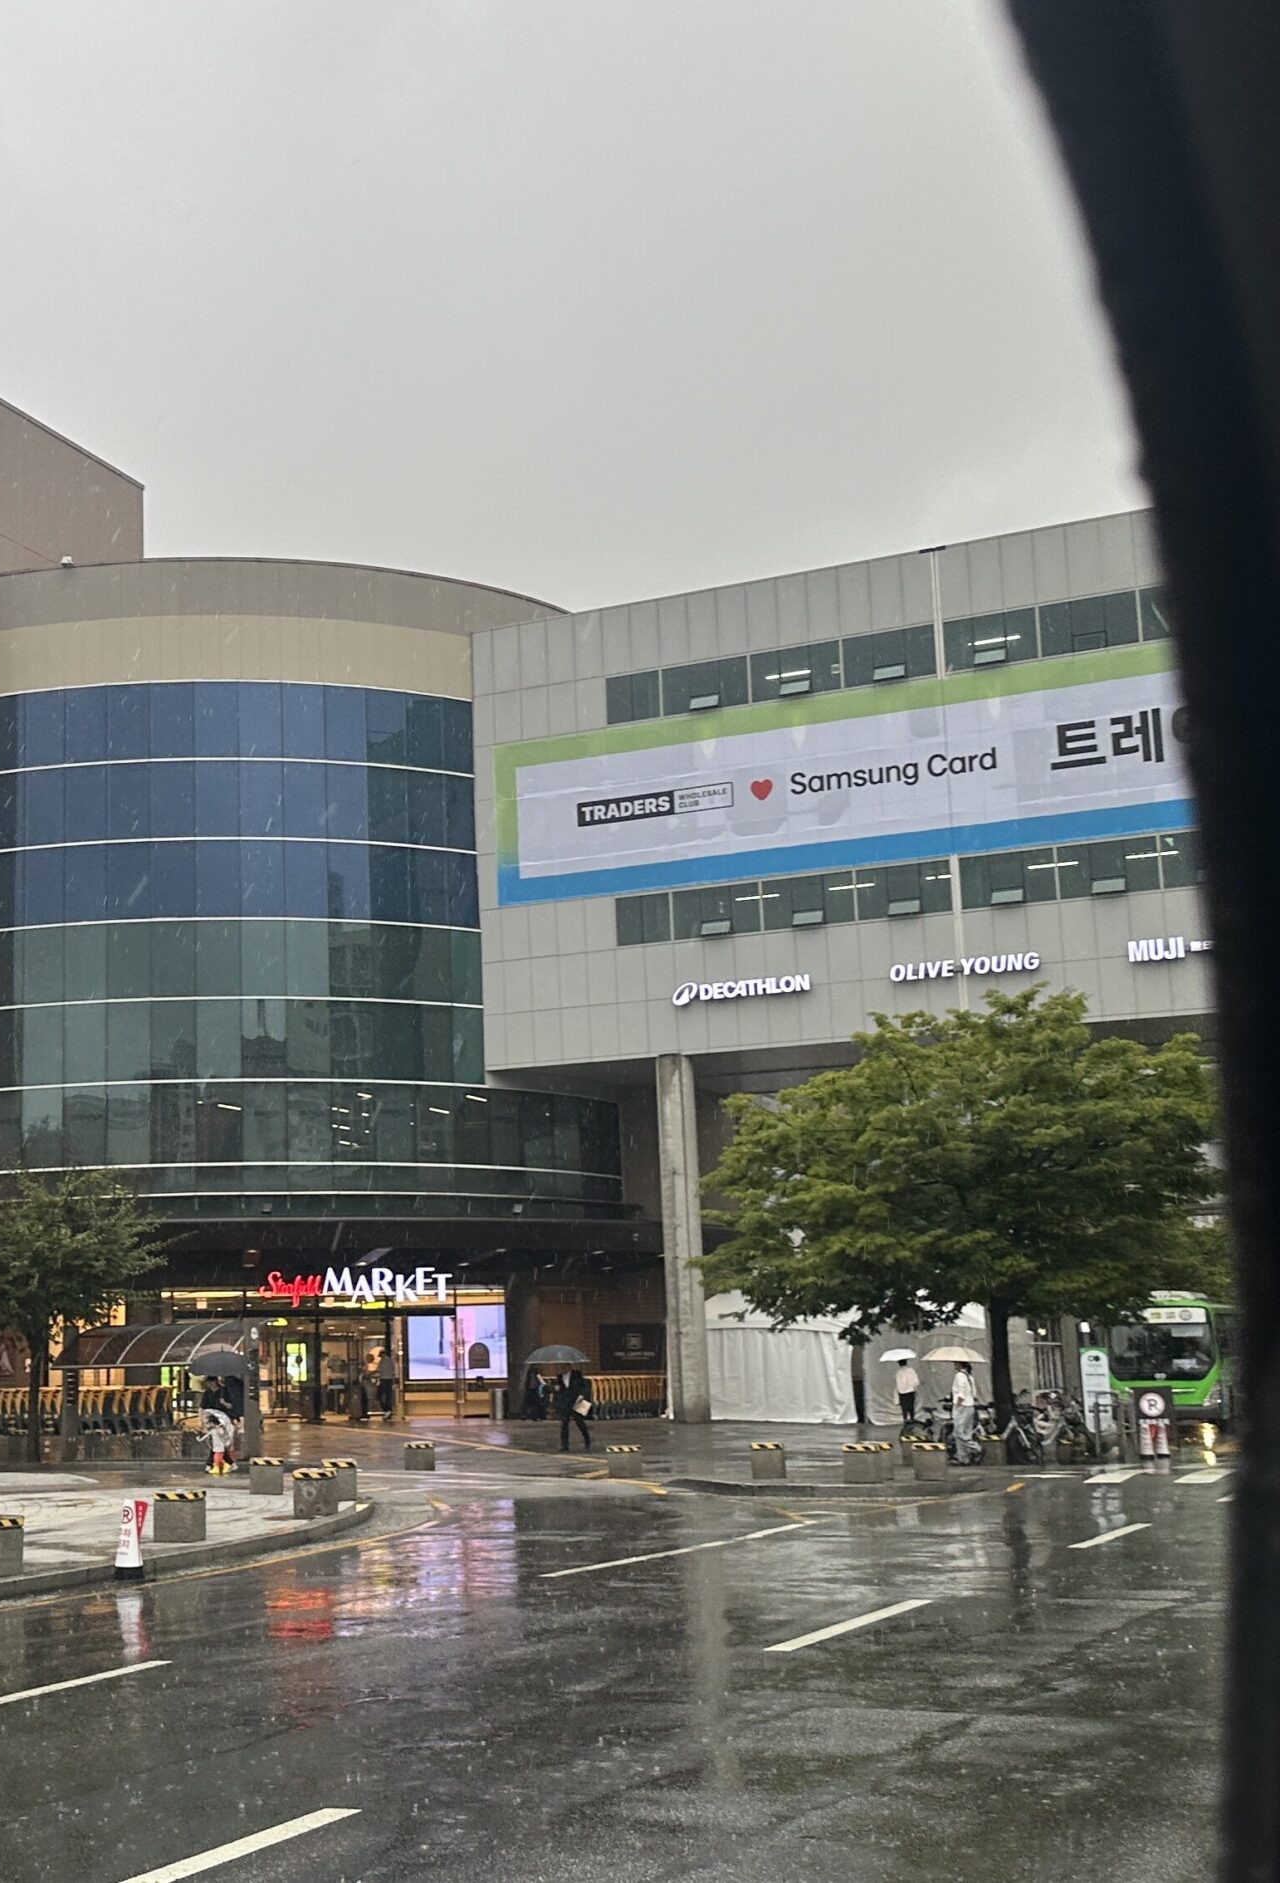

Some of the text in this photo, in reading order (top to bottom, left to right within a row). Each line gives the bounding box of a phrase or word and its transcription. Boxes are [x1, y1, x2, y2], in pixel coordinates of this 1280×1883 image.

[1051, 705, 1190, 771] 트레
[790, 747, 997, 796] Samsung Card
[581, 787, 728, 822] TRADERS WHOLESALE
[678, 800, 700, 809] CLUB
[1128, 936, 1185, 962] MUJI
[889, 952, 1040, 982] OLIVE YOUNG
[698, 974, 811, 1001] DECATHLON
[322, 1267, 453, 1303] MARKET
